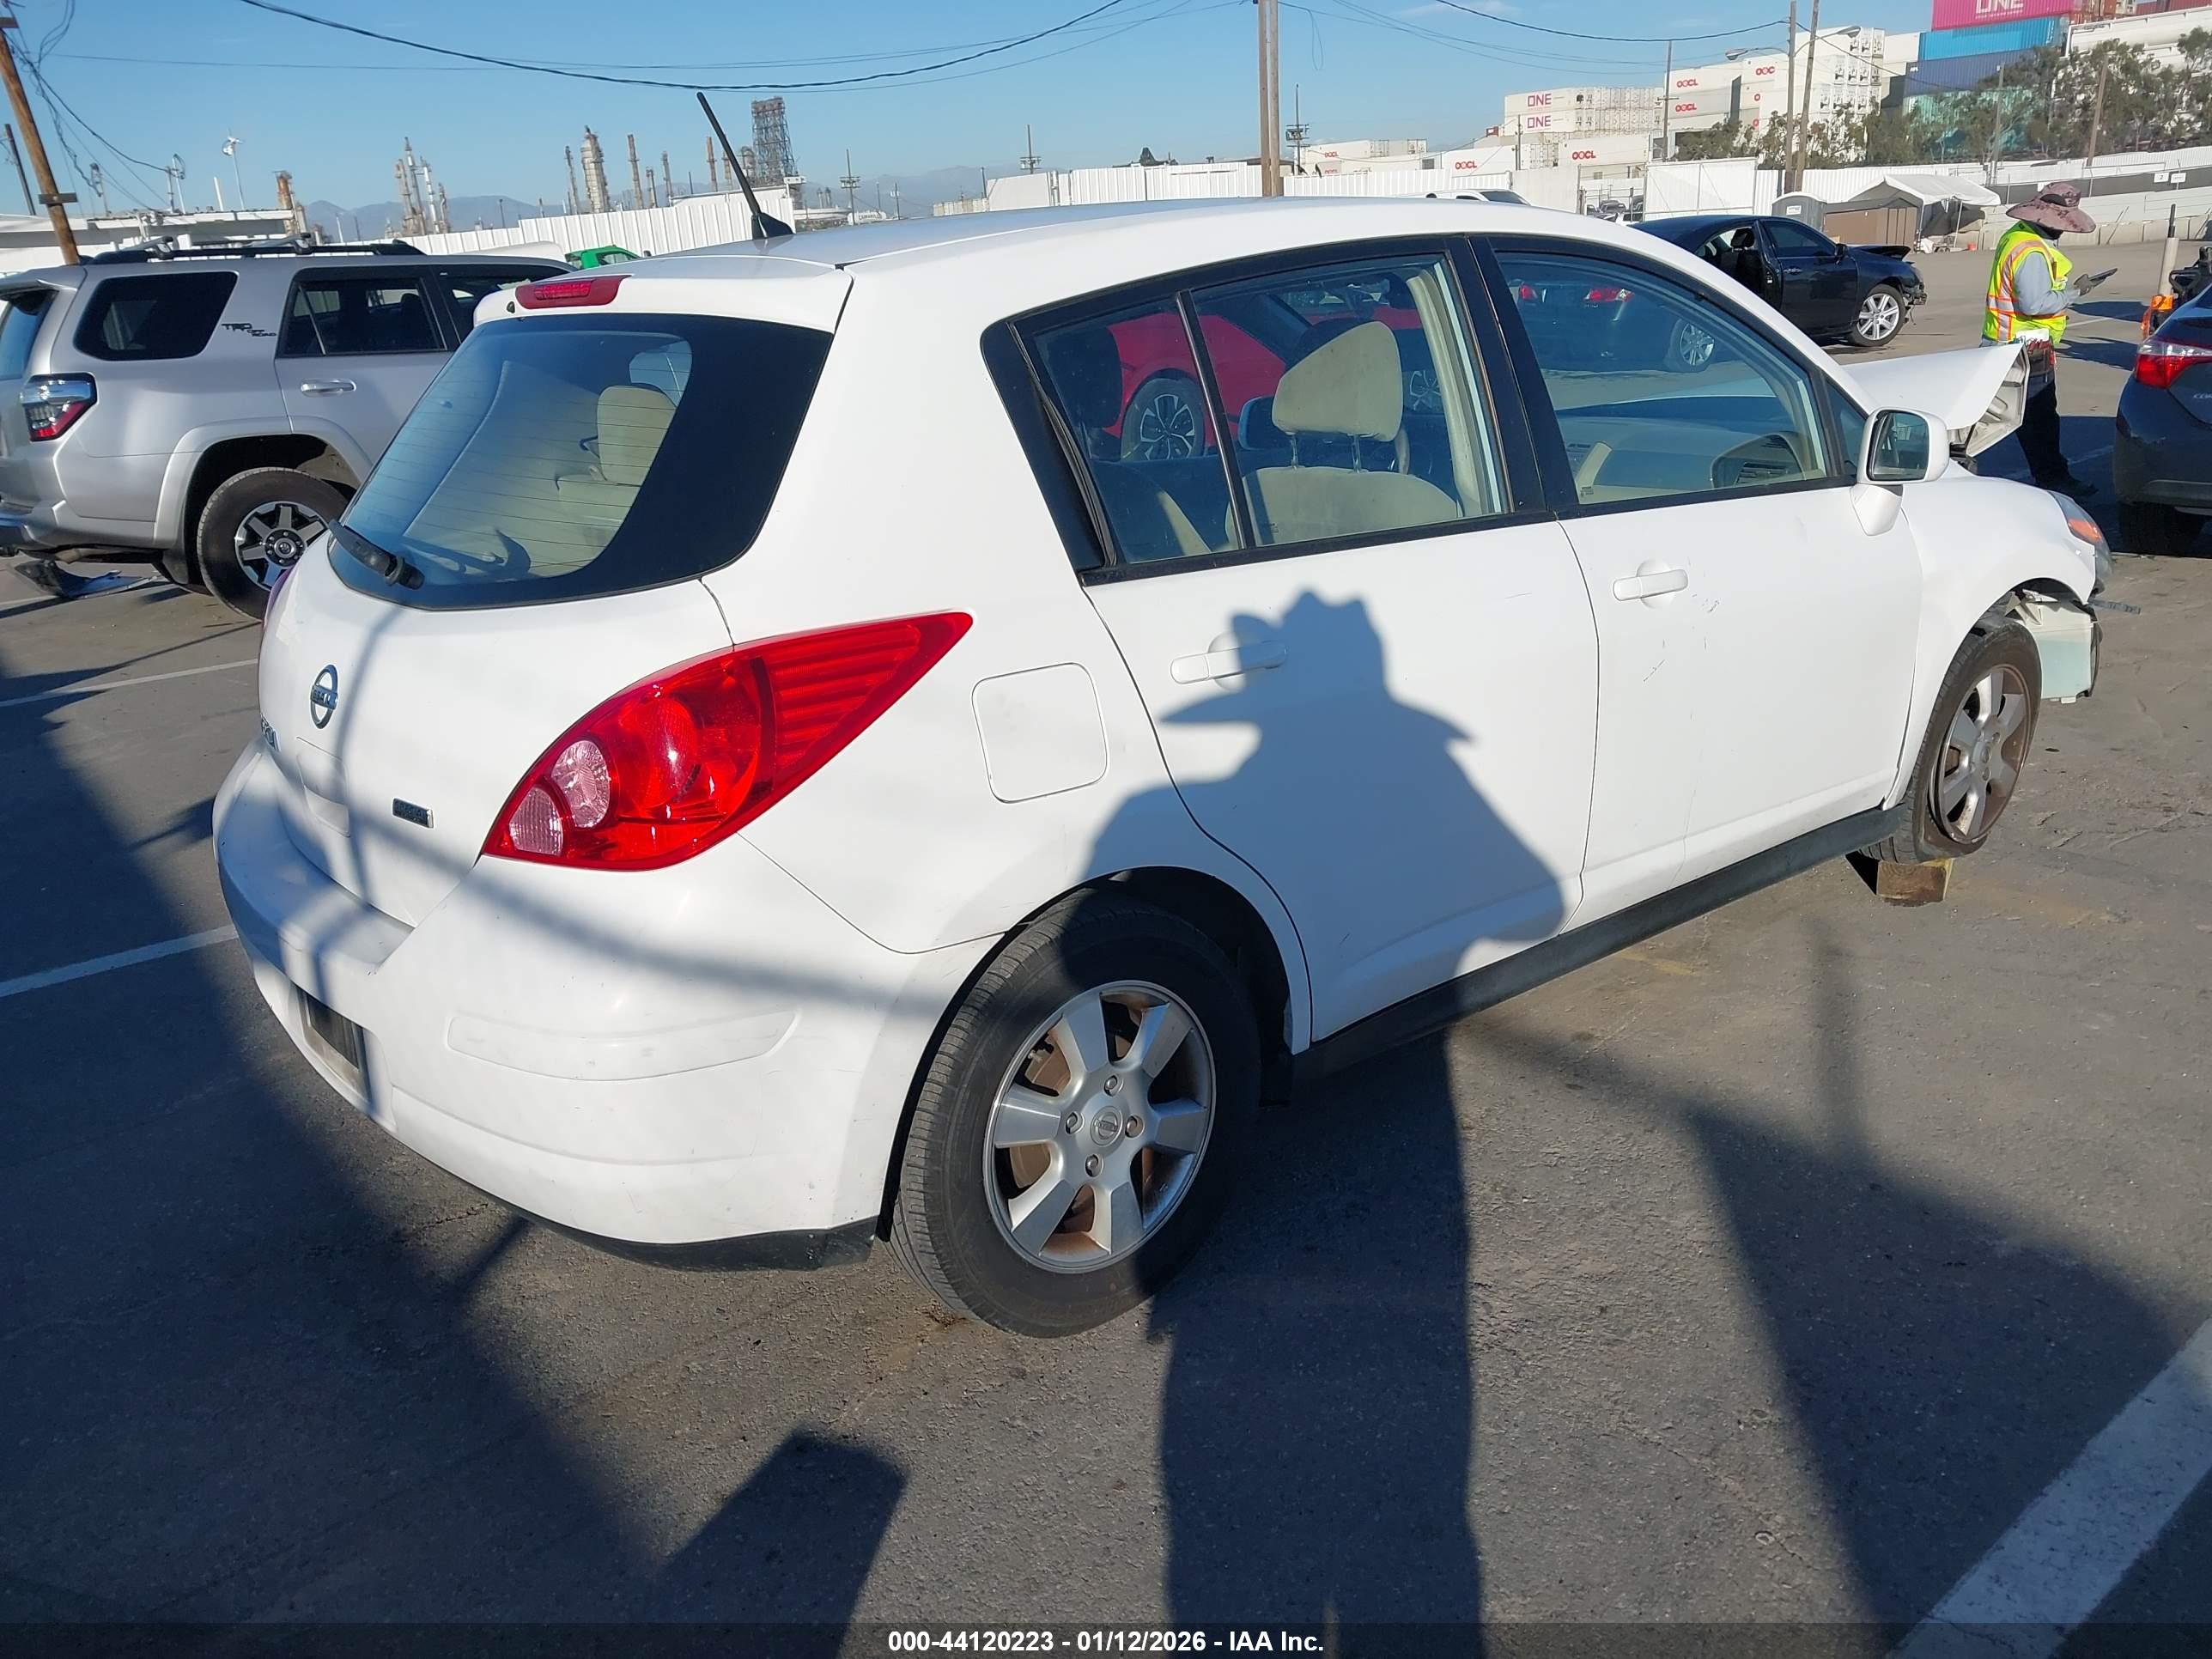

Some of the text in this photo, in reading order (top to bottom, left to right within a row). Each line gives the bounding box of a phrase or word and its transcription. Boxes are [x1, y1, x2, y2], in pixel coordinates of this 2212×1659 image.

[1676, 78, 1698, 88] OOCL
[1528, 93, 1552, 106] ONE
[1675, 103, 1697, 112] OOCL
[1527, 115, 1552, 128] ONE
[1571, 150, 1596, 160] OOCL
[1455, 160, 1477, 169] OOCL
